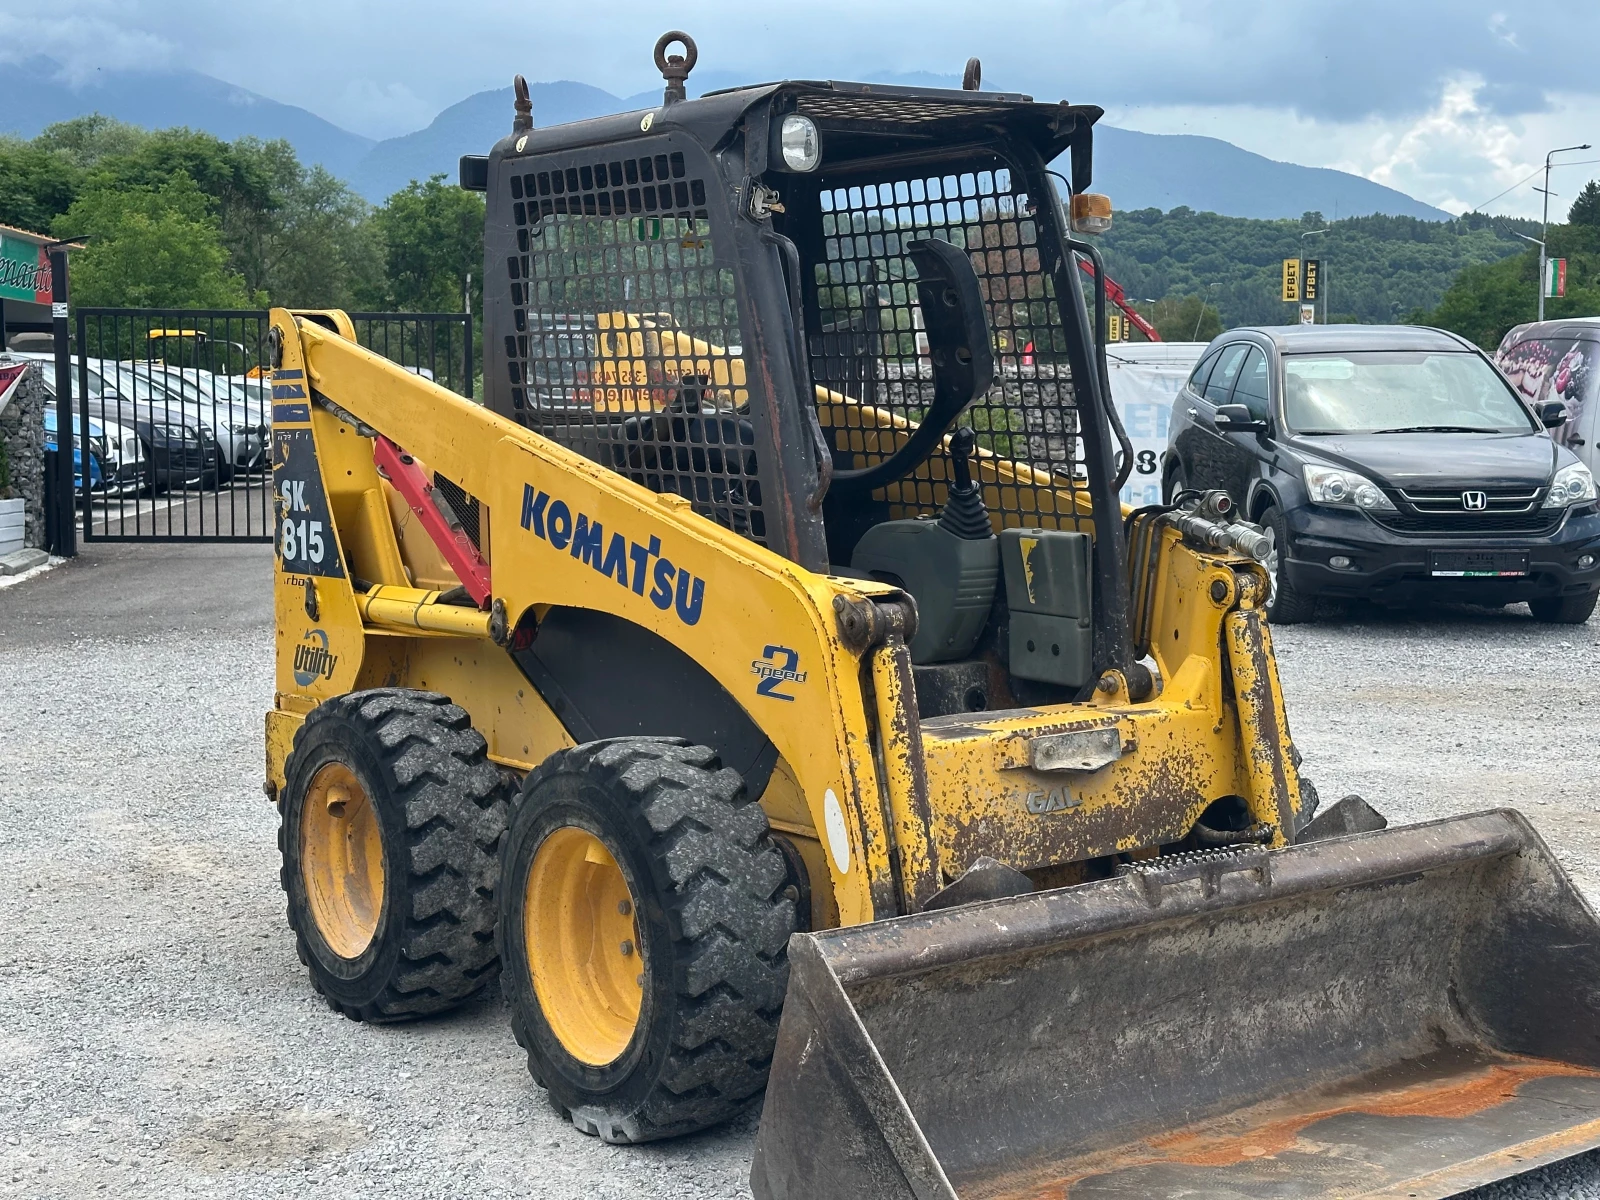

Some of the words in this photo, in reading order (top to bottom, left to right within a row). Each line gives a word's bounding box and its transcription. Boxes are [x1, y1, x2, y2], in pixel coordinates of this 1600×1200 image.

[1287, 263, 1295, 298] EFBET
[1306, 262, 1316, 299] EFBET
[281, 479, 306, 512] SK
[282, 518, 324, 564] 815
[520, 482, 706, 626] KOMATSU
[293, 643, 338, 680] Utility
[750, 660, 808, 683] Speed
[756, 644, 798, 702] 2
